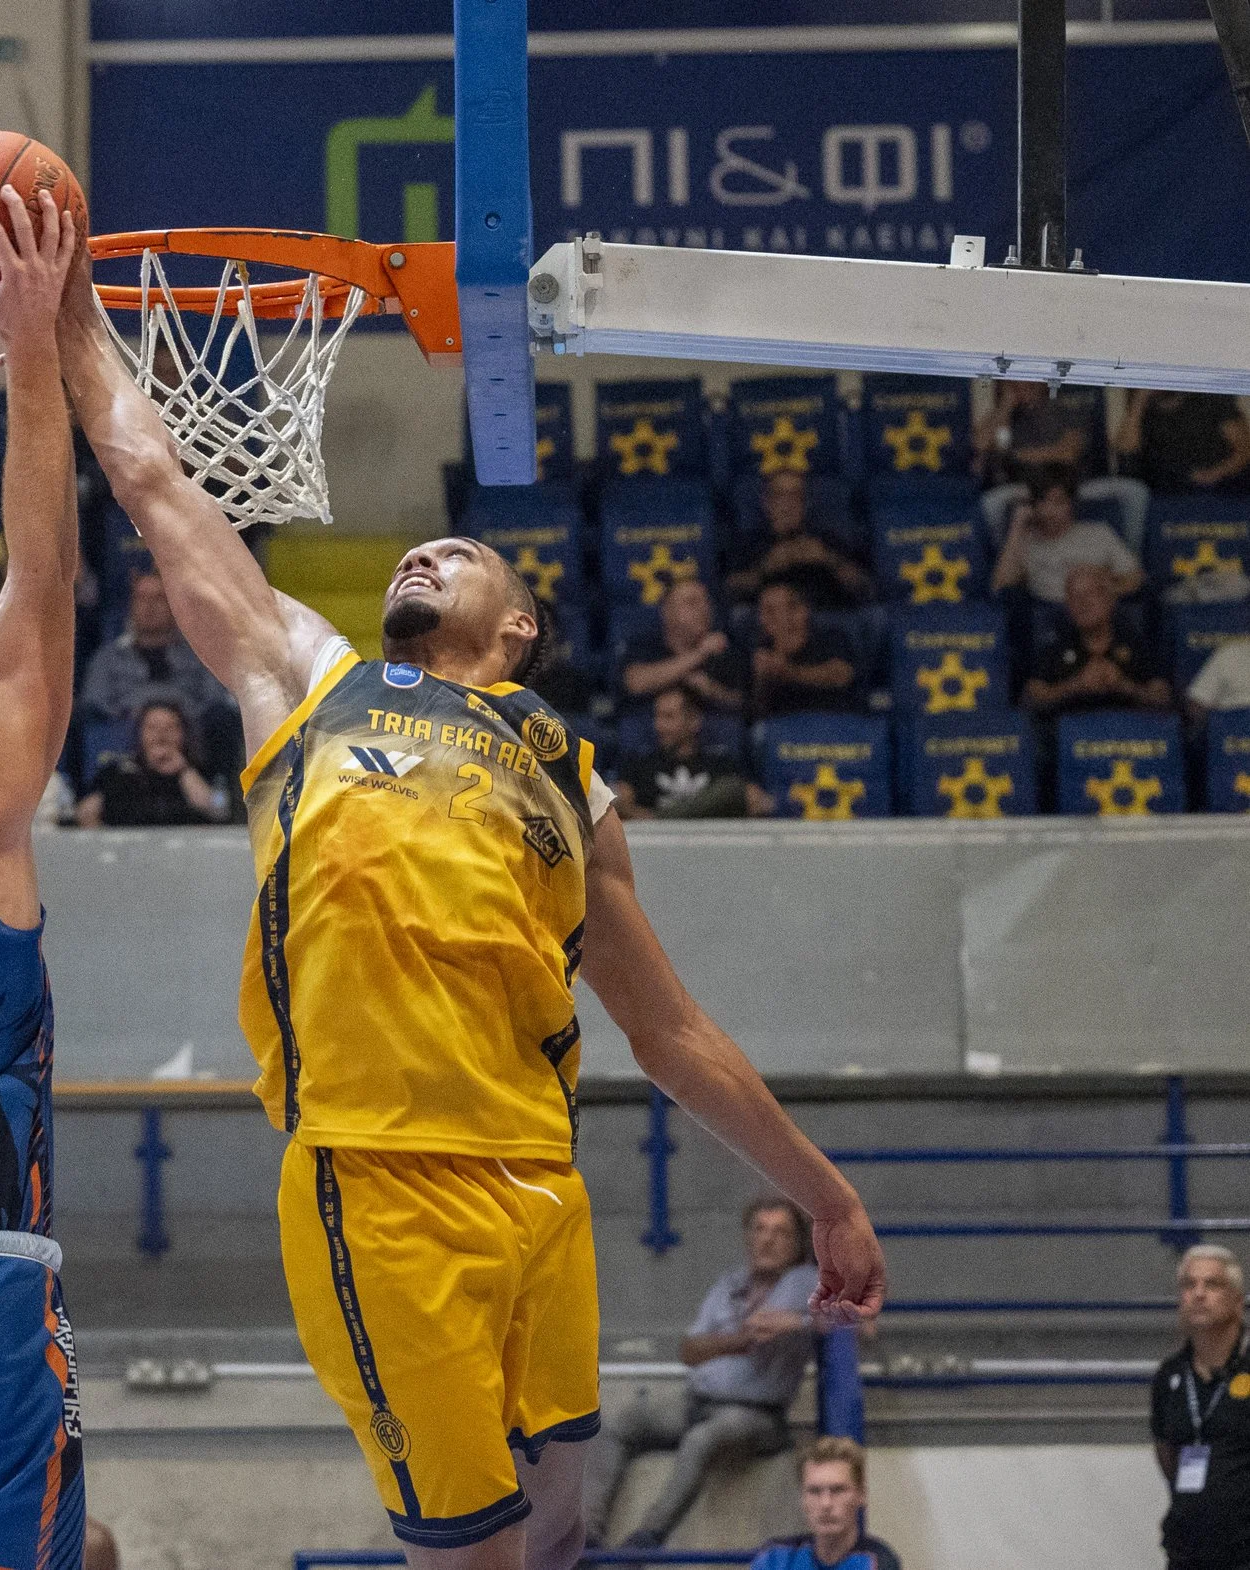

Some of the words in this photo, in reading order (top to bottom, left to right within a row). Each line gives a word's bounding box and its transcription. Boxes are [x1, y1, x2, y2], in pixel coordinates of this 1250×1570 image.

[367, 708, 432, 741] TRIA
[439, 723, 492, 757] EKA
[497, 743, 542, 782] AEL
[338, 775, 368, 787] WISE
[371, 779, 419, 800] WOLVES
[448, 761, 494, 826] 2
